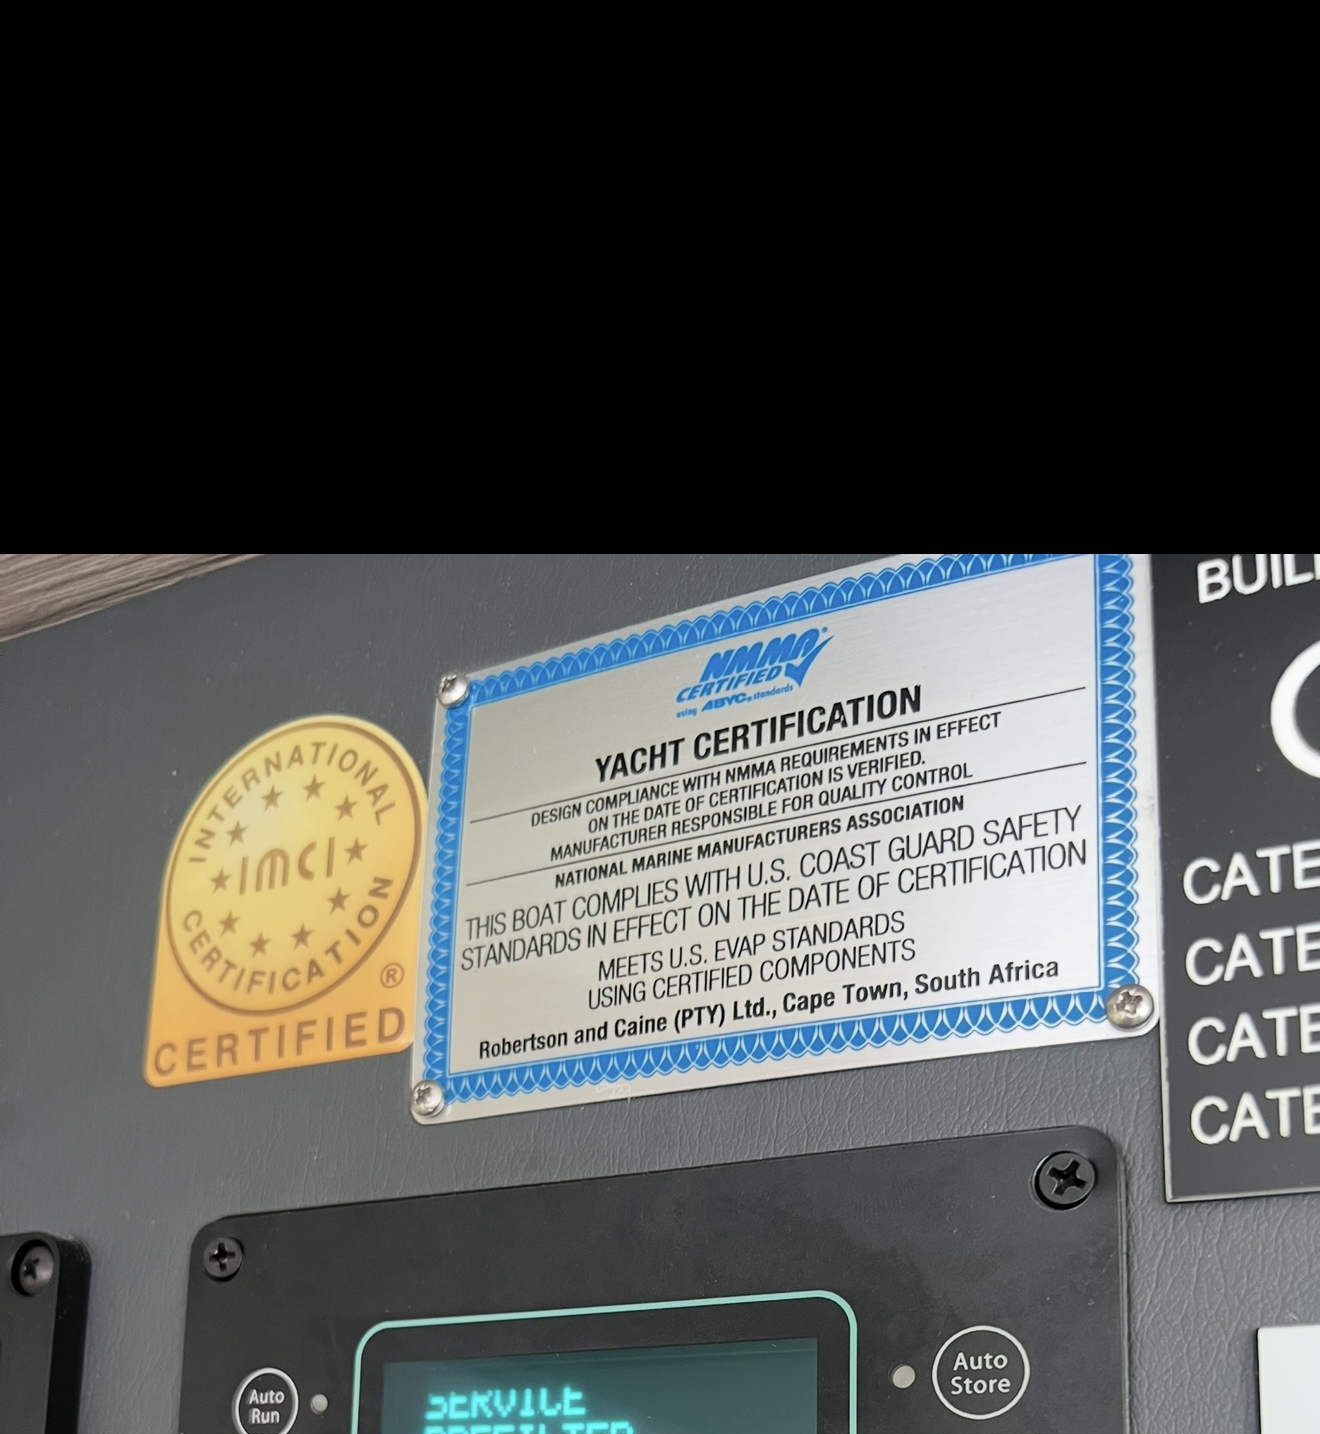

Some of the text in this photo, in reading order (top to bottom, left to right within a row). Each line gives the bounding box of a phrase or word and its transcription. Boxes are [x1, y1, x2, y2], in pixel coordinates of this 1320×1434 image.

[1199, 554, 1320, 604] BUIL
[676, 665, 782, 703] CERTIFIED
[700, 628, 820, 682] NMMA
[595, 684, 922, 783] YACHT CERTIFICATION
[676, 707, 698, 718] using
[753, 683, 793, 700] standards
[188, 741, 397, 865] INTERNATIONAL
[531, 711, 1002, 827] DESIGN COMPLIANCE WITH NMMA REQUIREMENTS IN EFFECT
[588, 750, 926, 834] ON THE DATE OF CERTIFICATION IS VERIFIED.
[550, 762, 973, 862] MANUFACTURER RESPONSIBLE FOR QUALITY CONTROL
[555, 795, 965, 888] NATIONAL MARINE MANUFACTURERS ASSOCIATION
[460, 838, 1087, 971] STANDARDS IN EFFECT ON THE DATE OF CERTIFICATION
[466, 804, 1082, 941] THIS BOAT COMPLIES WITH U.S. COAST GUARD SAFETY
[183, 875, 395, 995] CERTIFICATION
[598, 910, 905, 982] MEETS U.S. EVAP STANDARDS
[478, 960, 1059, 1061] Robertson and Caine (PTY) Ltd., Cape Town, South Africa
[588, 938, 916, 1011] USING CERTIFIED COMPONENTS
[154, 1006, 407, 1077] CERTIFIED
[248, 1389, 285, 1405] Auto
[951, 1376, 1011, 1395] Store
[953, 1352, 1008, 1371] Auto
[250, 1408, 280, 1424] Run
